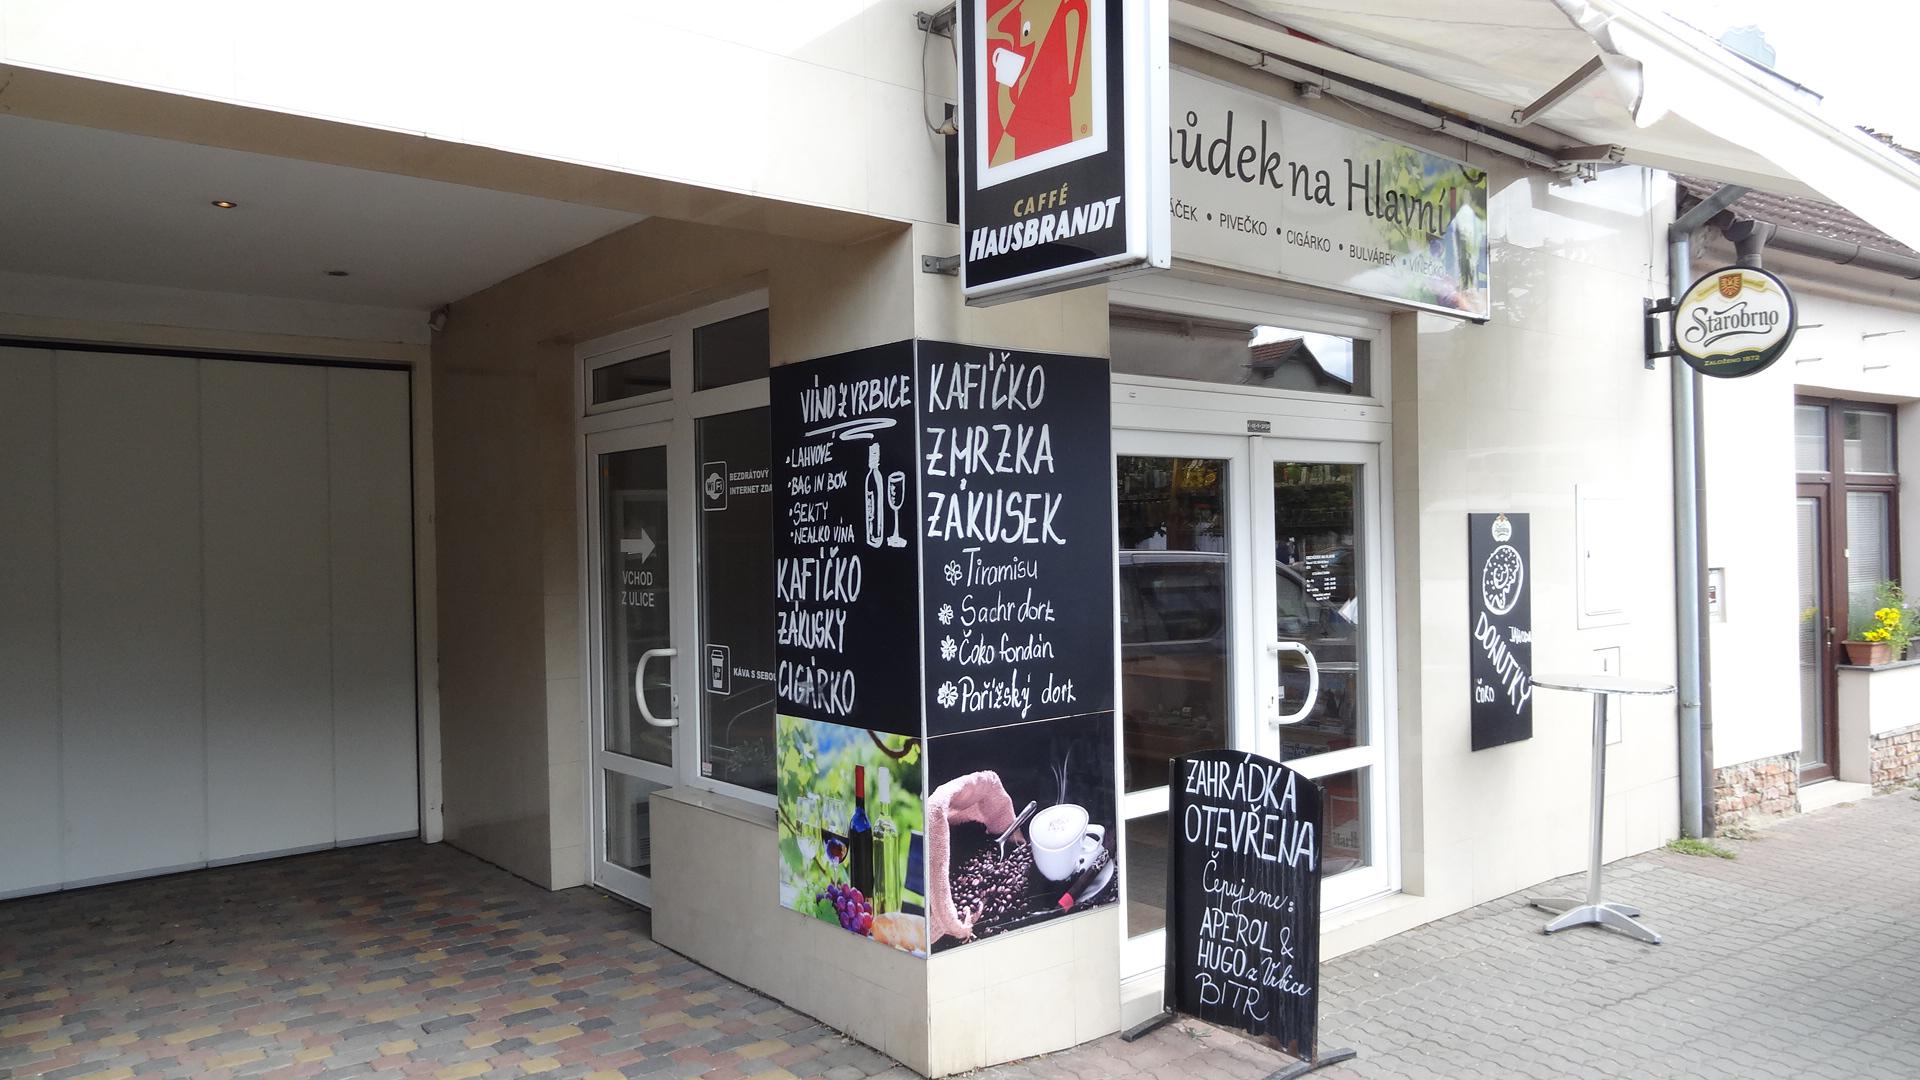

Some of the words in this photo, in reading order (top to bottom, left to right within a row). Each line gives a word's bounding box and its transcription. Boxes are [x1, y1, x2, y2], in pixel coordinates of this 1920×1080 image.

[1169, 110, 1284, 189] ůdek
[1288, 160, 1335, 208] na
[1344, 158, 1447, 237] Hlavní
[1013, 182, 1069, 217] CAFFÉ
[969, 196, 1121, 262] HAUSBRANDT
[1219, 213, 1268, 236] PIVEČKO
[1286, 229, 1331, 252] CIGÁRKO
[1349, 243, 1396, 267] BULVÁREK
[1685, 302, 1779, 346] Starobrno
[800, 375, 836, 423] VÍNO
[850, 375, 912, 417] VRBICE
[928, 352, 1045, 412] KAFÍČKO
[791, 431, 833, 467] LAHVOVÉ
[926, 424, 1054, 476] ZMRZKA
[729, 467, 770, 481] BEZDRÁTOVÝ
[729, 484, 760, 495] INTERNET
[791, 476, 811, 495] BAG
[814, 477, 823, 492] IN
[827, 471, 848, 490] BOX
[794, 501, 829, 522] SEKTY
[927, 478, 1066, 545] ZÁKUSEK
[794, 529, 830, 544] NEALKO
[622, 570, 653, 586] VCHOD
[777, 546, 861, 603] KAFÍČKO
[962, 547, 1038, 586] Tiramisu
[621, 590, 627, 605] Z
[629, 591, 655, 607] ULICE
[960, 595, 1015, 626] Sachr
[1018, 588, 1055, 622] dort
[777, 600, 847, 653] ZÁKUSKY
[959, 629, 995, 665] Čoko
[999, 633, 1054, 664] fondán
[733, 666, 750, 678] KÁVA
[751, 670, 756, 679] S
[778, 655, 856, 715] CIGÁRKO
[1475, 612, 1532, 714] DONUTKY
[957, 668, 1031, 718] Pařížský
[1041, 678, 1076, 704] dort
[1186, 753, 1296, 813] ZAHRÁDKA
[1184, 804, 1316, 872] OTEVŘENA
[1200, 907, 1272, 953] APEROL
[1279, 926, 1294, 959] &
[1198, 938, 1246, 978] HUGO
[1261, 956, 1312, 997] Vrbice
[1195, 972, 1269, 1021] BITR
